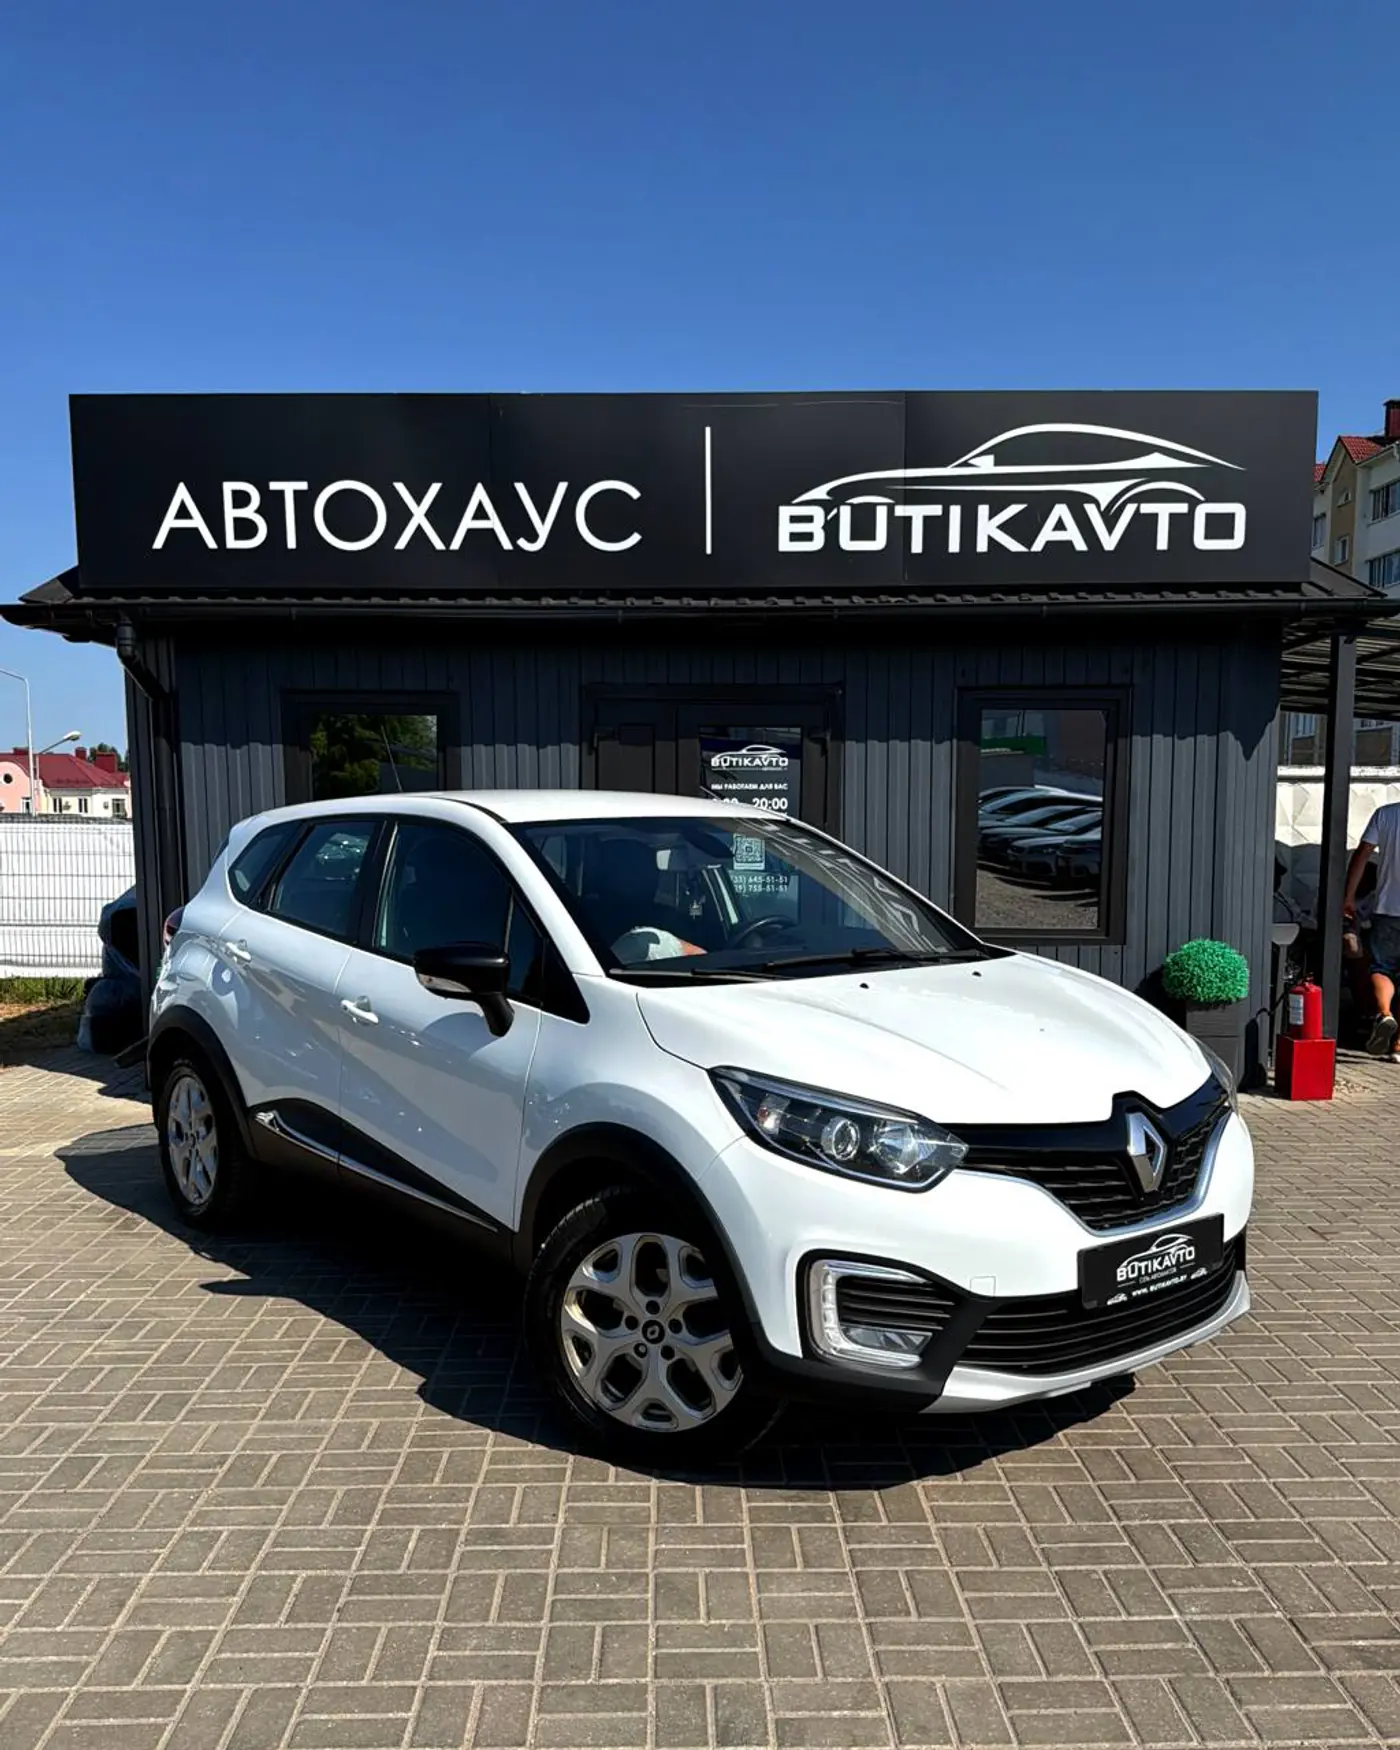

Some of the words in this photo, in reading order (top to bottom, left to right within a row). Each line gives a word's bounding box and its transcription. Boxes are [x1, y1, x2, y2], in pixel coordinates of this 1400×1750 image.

[152, 479, 643, 552] АВТОХАУС
[777, 501, 1247, 553] BUTIKAVTO
[711, 757, 789, 767] BUTIKAVTO
[759, 783, 774, 791] ДЛЯ
[752, 797, 789, 810] 20:00
[1116, 1246, 1195, 1281] BUTIKAVTO
